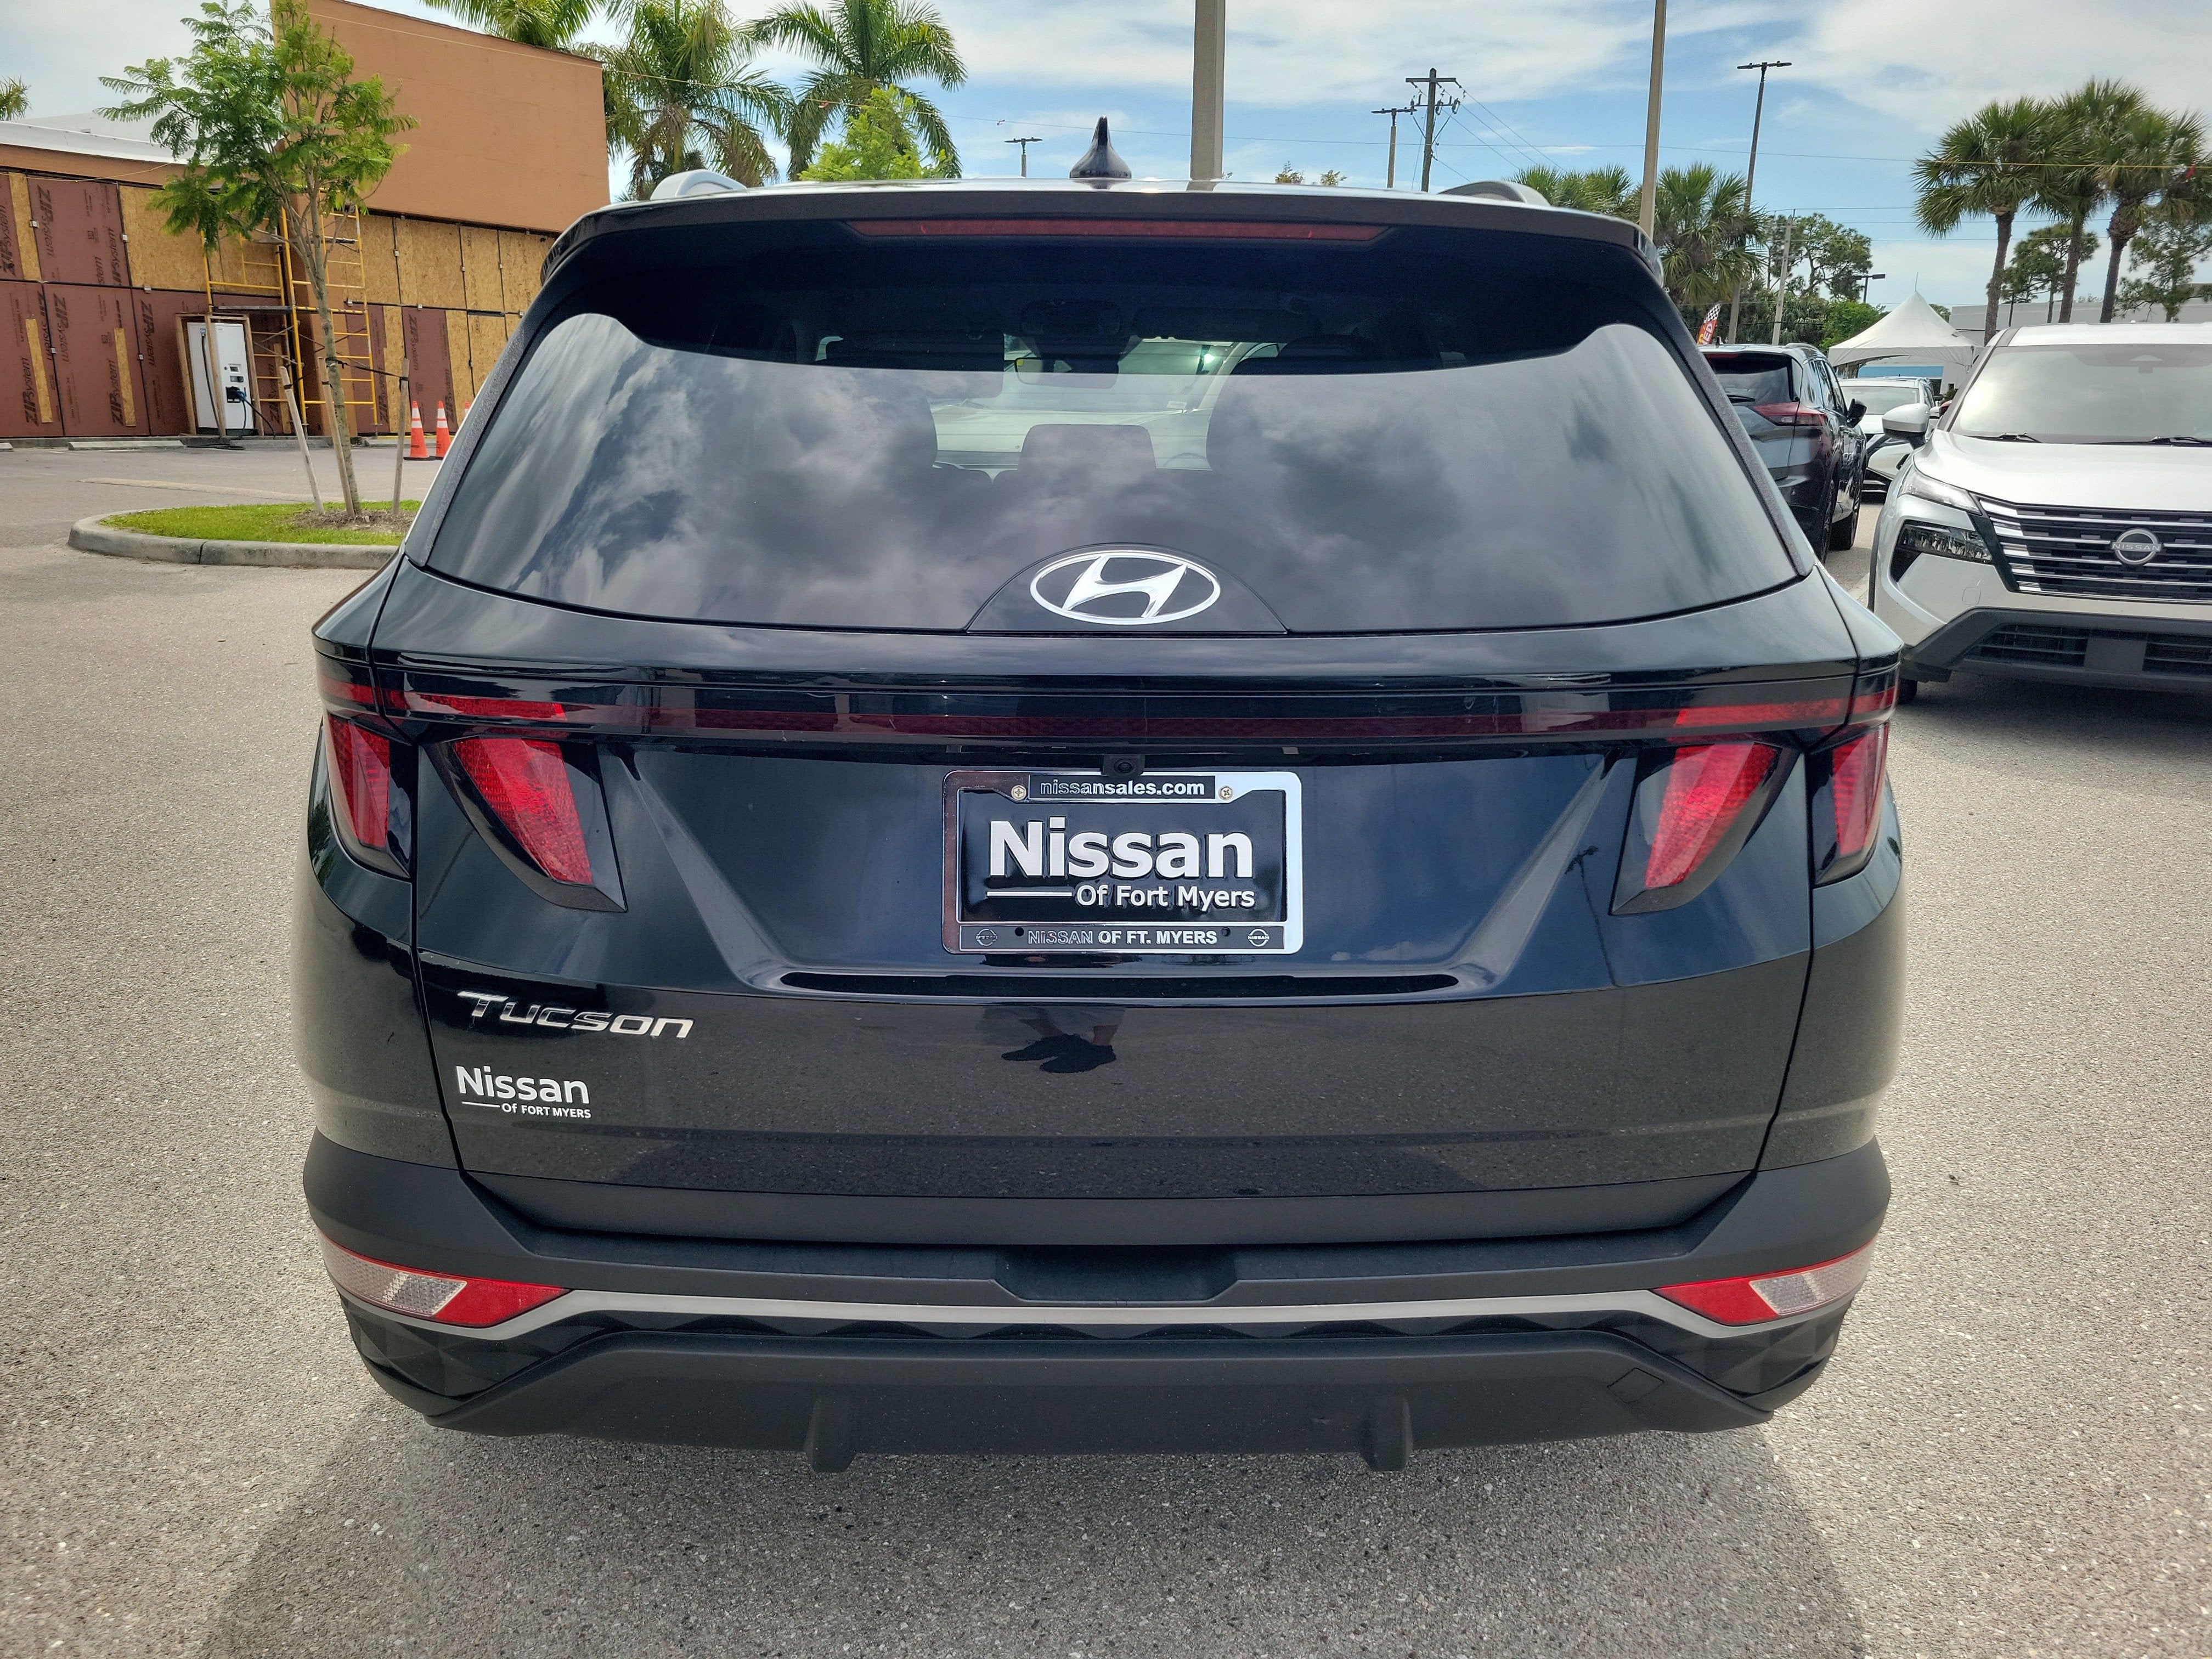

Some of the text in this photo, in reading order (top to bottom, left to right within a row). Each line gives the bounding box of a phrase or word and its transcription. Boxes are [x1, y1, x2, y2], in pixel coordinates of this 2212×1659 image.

[1040, 778, 1205, 796] nissansales.com
[990, 816, 1253, 878] Nissan
[1076, 885, 1255, 911] Of Fort Myers
[1028, 930, 1217, 944] NISSAN OF FT. MYERS
[457, 991, 694, 1039] TUCSON
[456, 1065, 590, 1104] Nissan
[522, 1105, 550, 1115] FORT
[553, 1107, 591, 1118] MYERS
